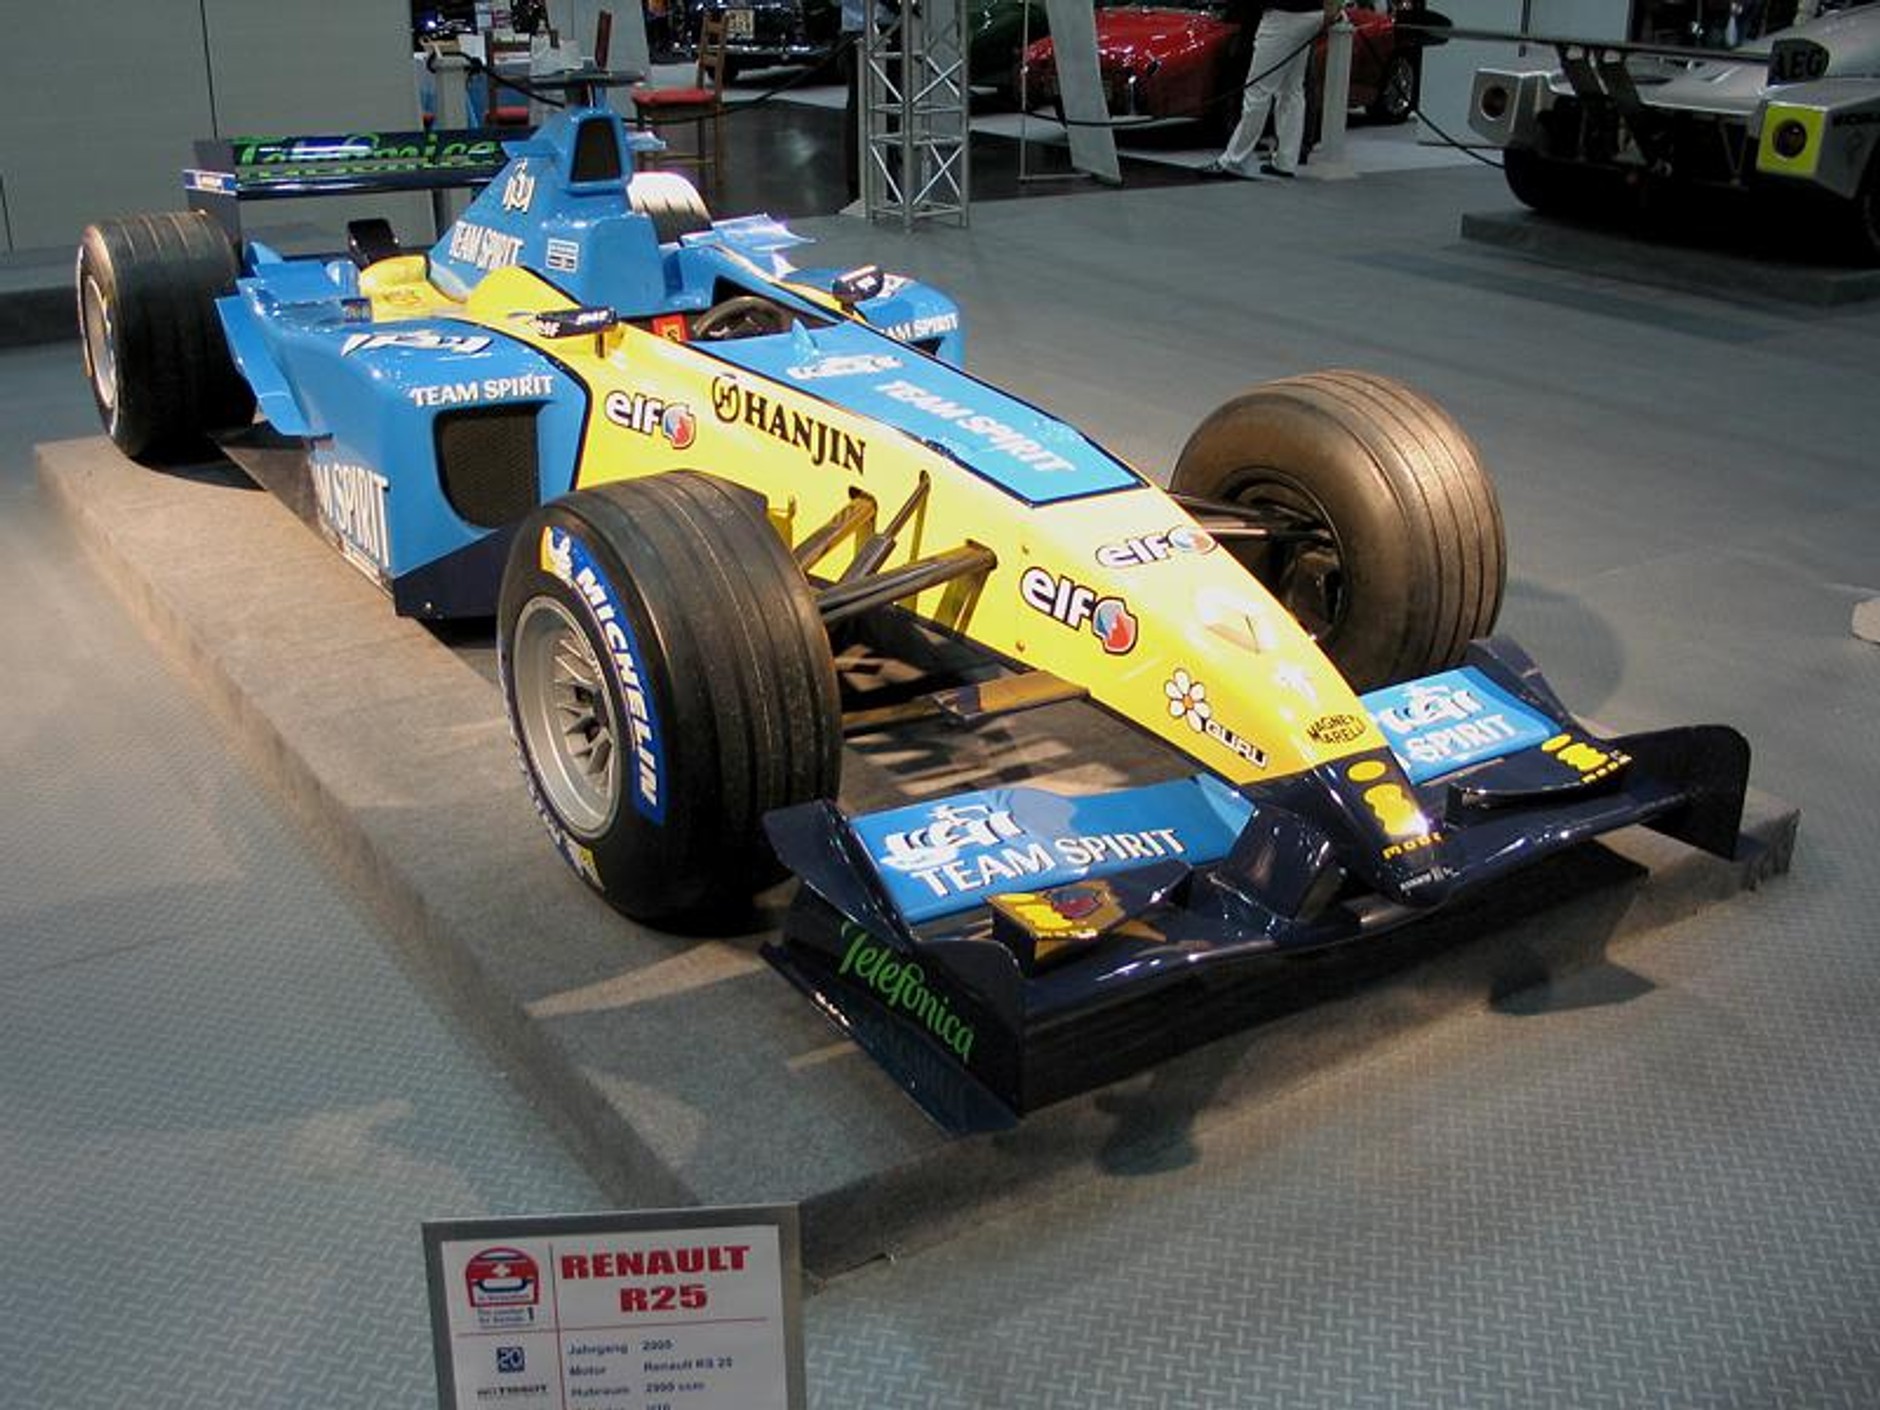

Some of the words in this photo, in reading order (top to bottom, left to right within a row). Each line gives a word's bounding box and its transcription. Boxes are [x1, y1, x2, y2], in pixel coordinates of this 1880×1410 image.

[408, 381, 479, 407] TEAM
[482, 374, 554, 400] SPIRIT
[604, 389, 664, 437] elf
[744, 389, 867, 476] HANJIN
[875, 379, 975, 420] TEAM
[956, 415, 1077, 472] SPIRIT
[1095, 532, 1172, 570] elf
[1020, 565, 1097, 631] elf
[573, 565, 659, 808] MICHELIN
[1404, 714, 1517, 764] SPIRIT
[911, 842, 1056, 898] TEAM
[1055, 829, 1186, 865] SPIRIT
[561, 1245, 751, 1280] RENAULT
[620, 1283, 708, 1313] R25
